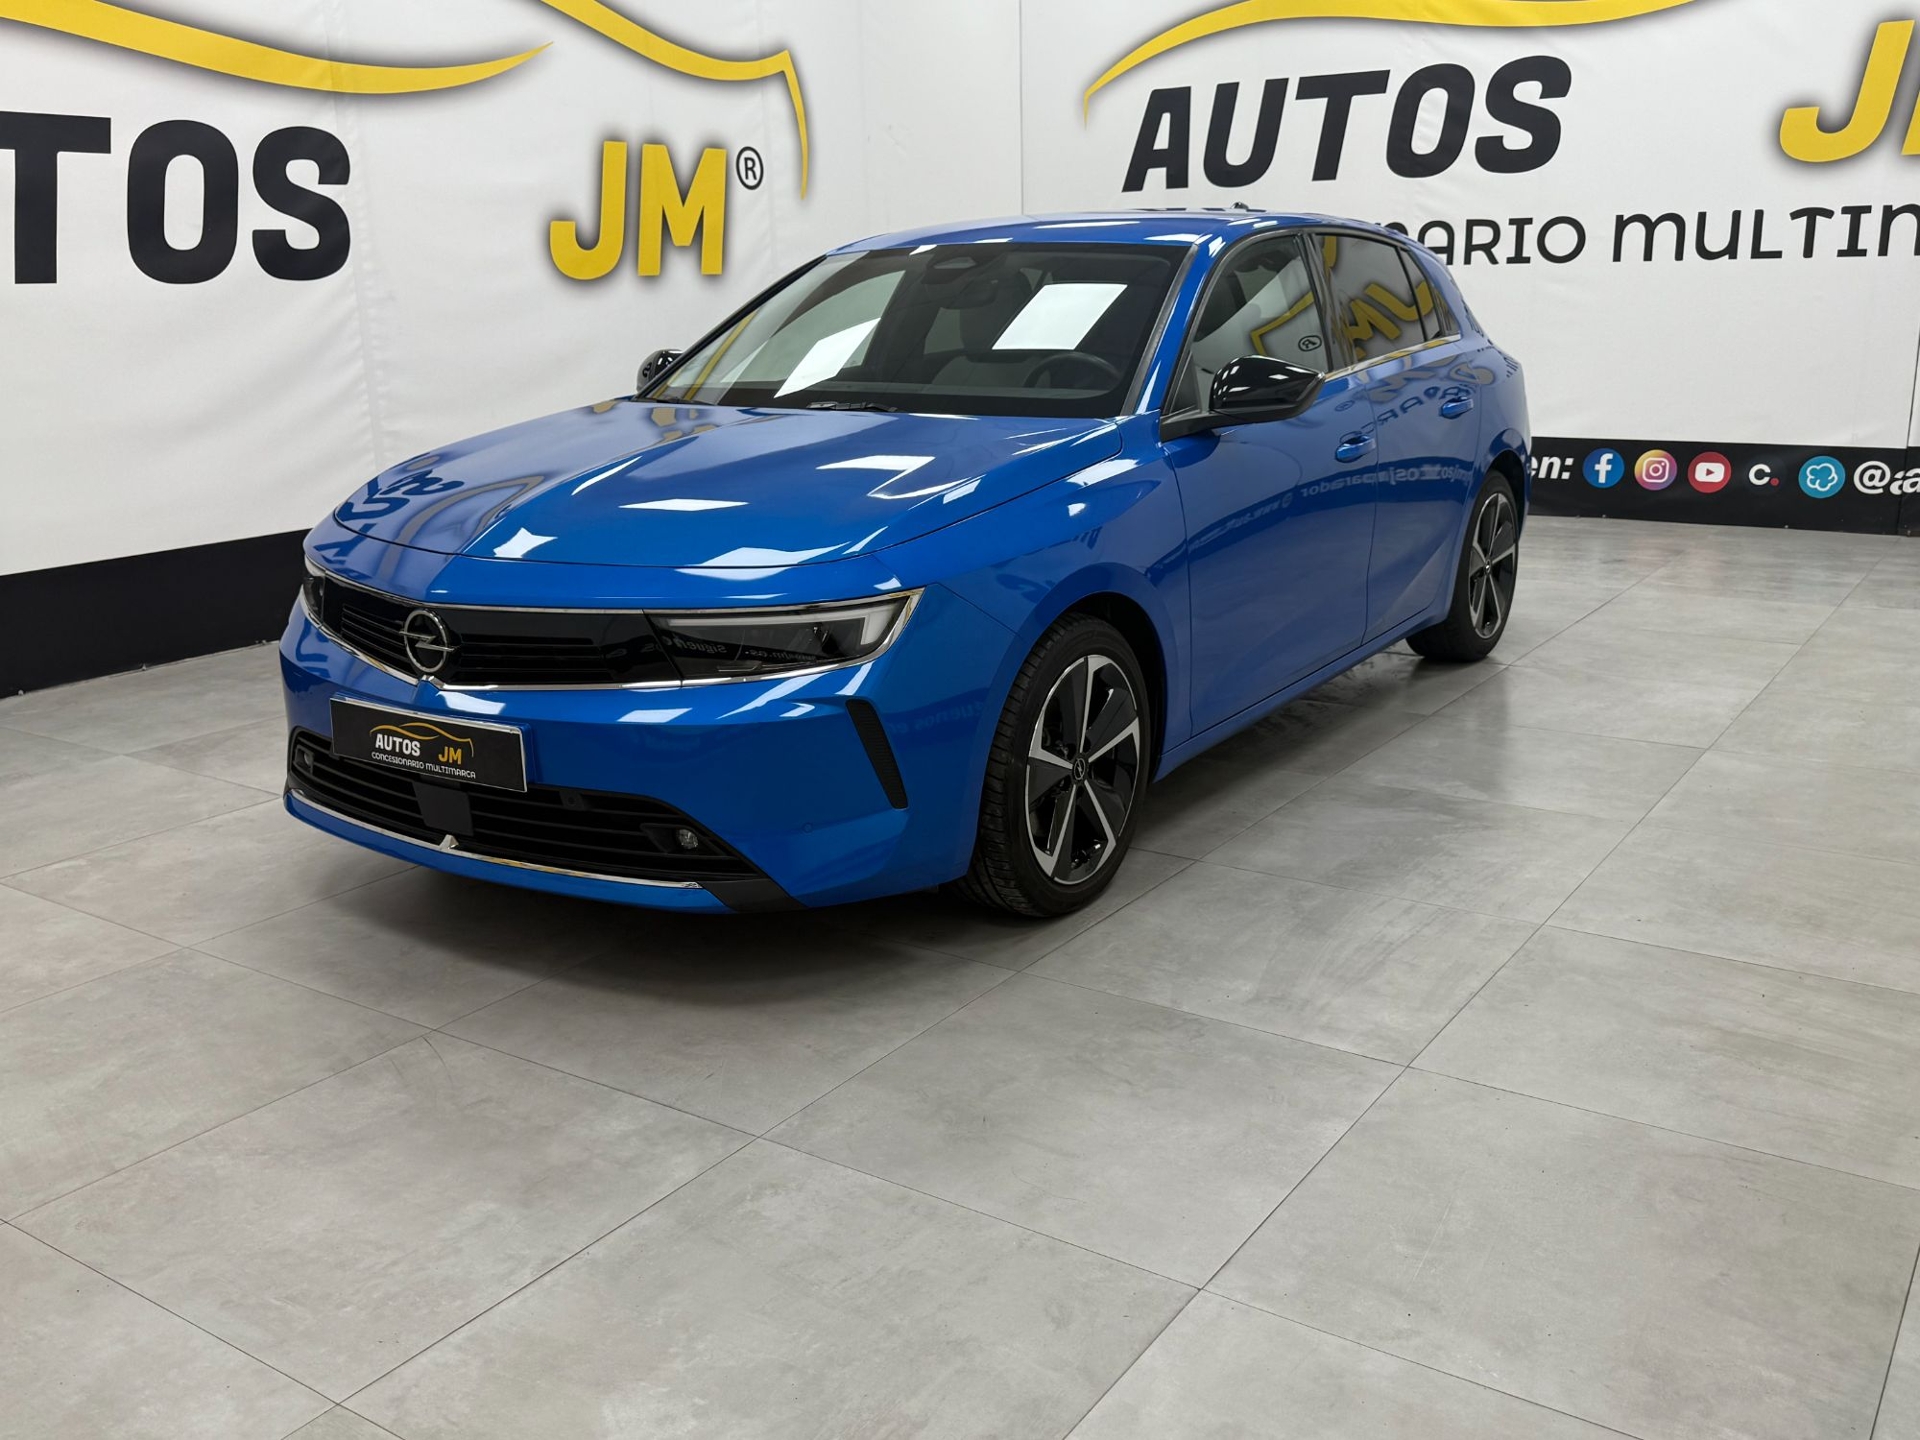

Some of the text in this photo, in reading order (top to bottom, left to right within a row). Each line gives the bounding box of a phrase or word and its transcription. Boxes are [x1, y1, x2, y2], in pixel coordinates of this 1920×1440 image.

[1121, 20, 1920, 193] AUTOS J
[1386, 214, 1587, 266] ARIO
[371, 751, 476, 779] CONCESIONARIO MULTIMARCA
[374, 733, 463, 765] AUTOS JM
